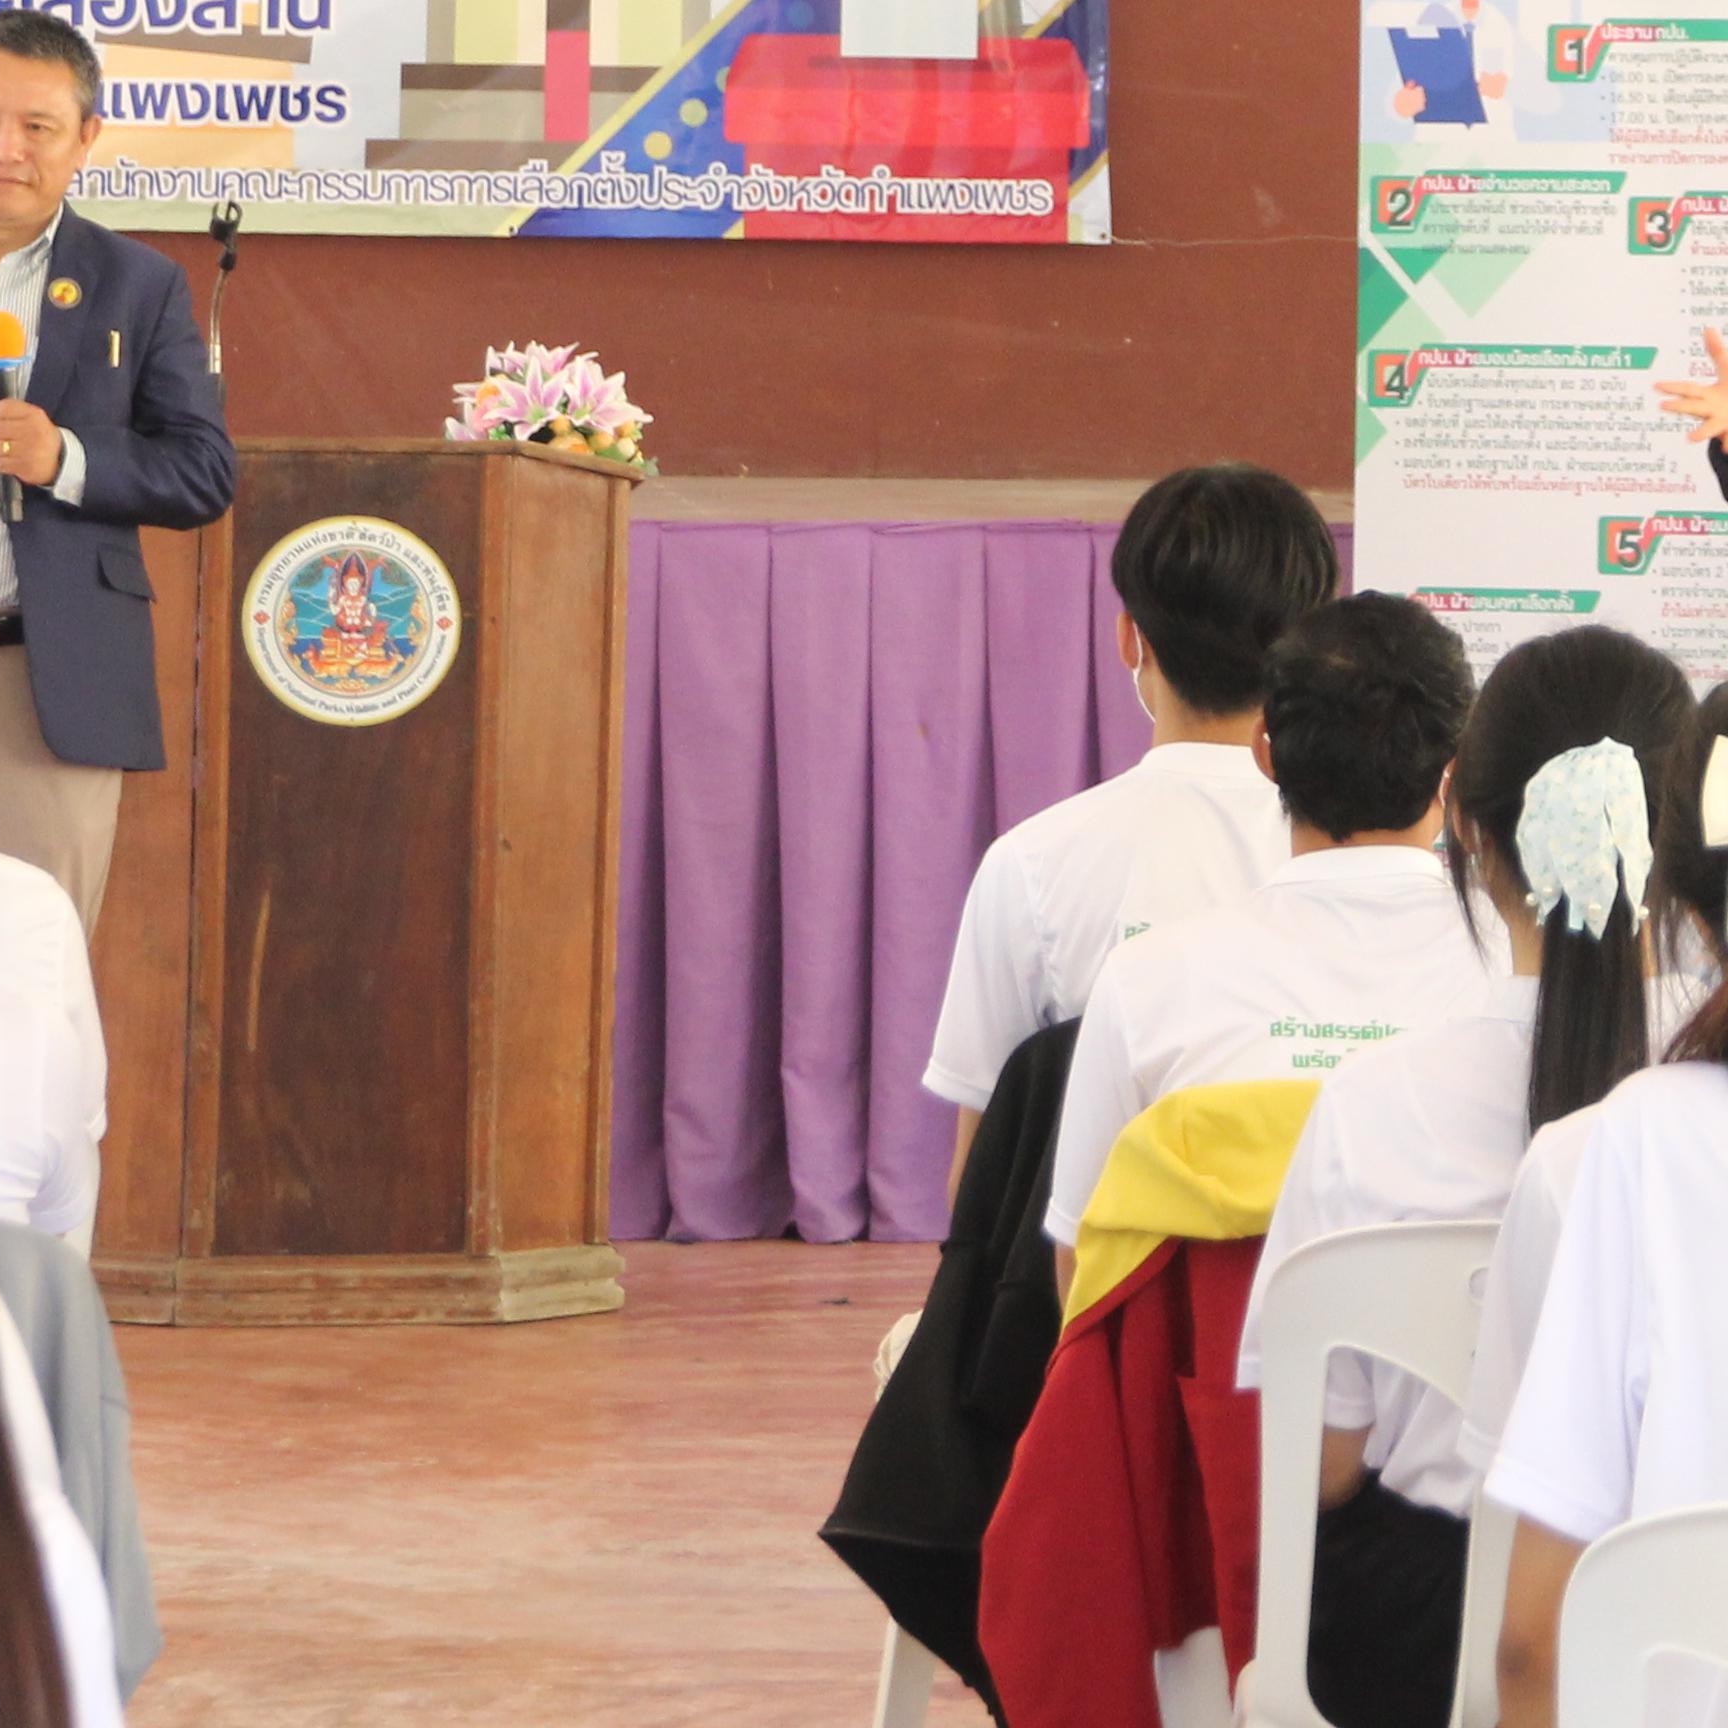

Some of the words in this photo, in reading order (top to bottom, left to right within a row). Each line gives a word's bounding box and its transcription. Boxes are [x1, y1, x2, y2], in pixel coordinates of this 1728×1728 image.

[1388, 187, 1412, 228] 2
[1646, 209, 1672, 251] 3
[1384, 361, 1408, 403] 4
[1618, 529, 1644, 571] 5
